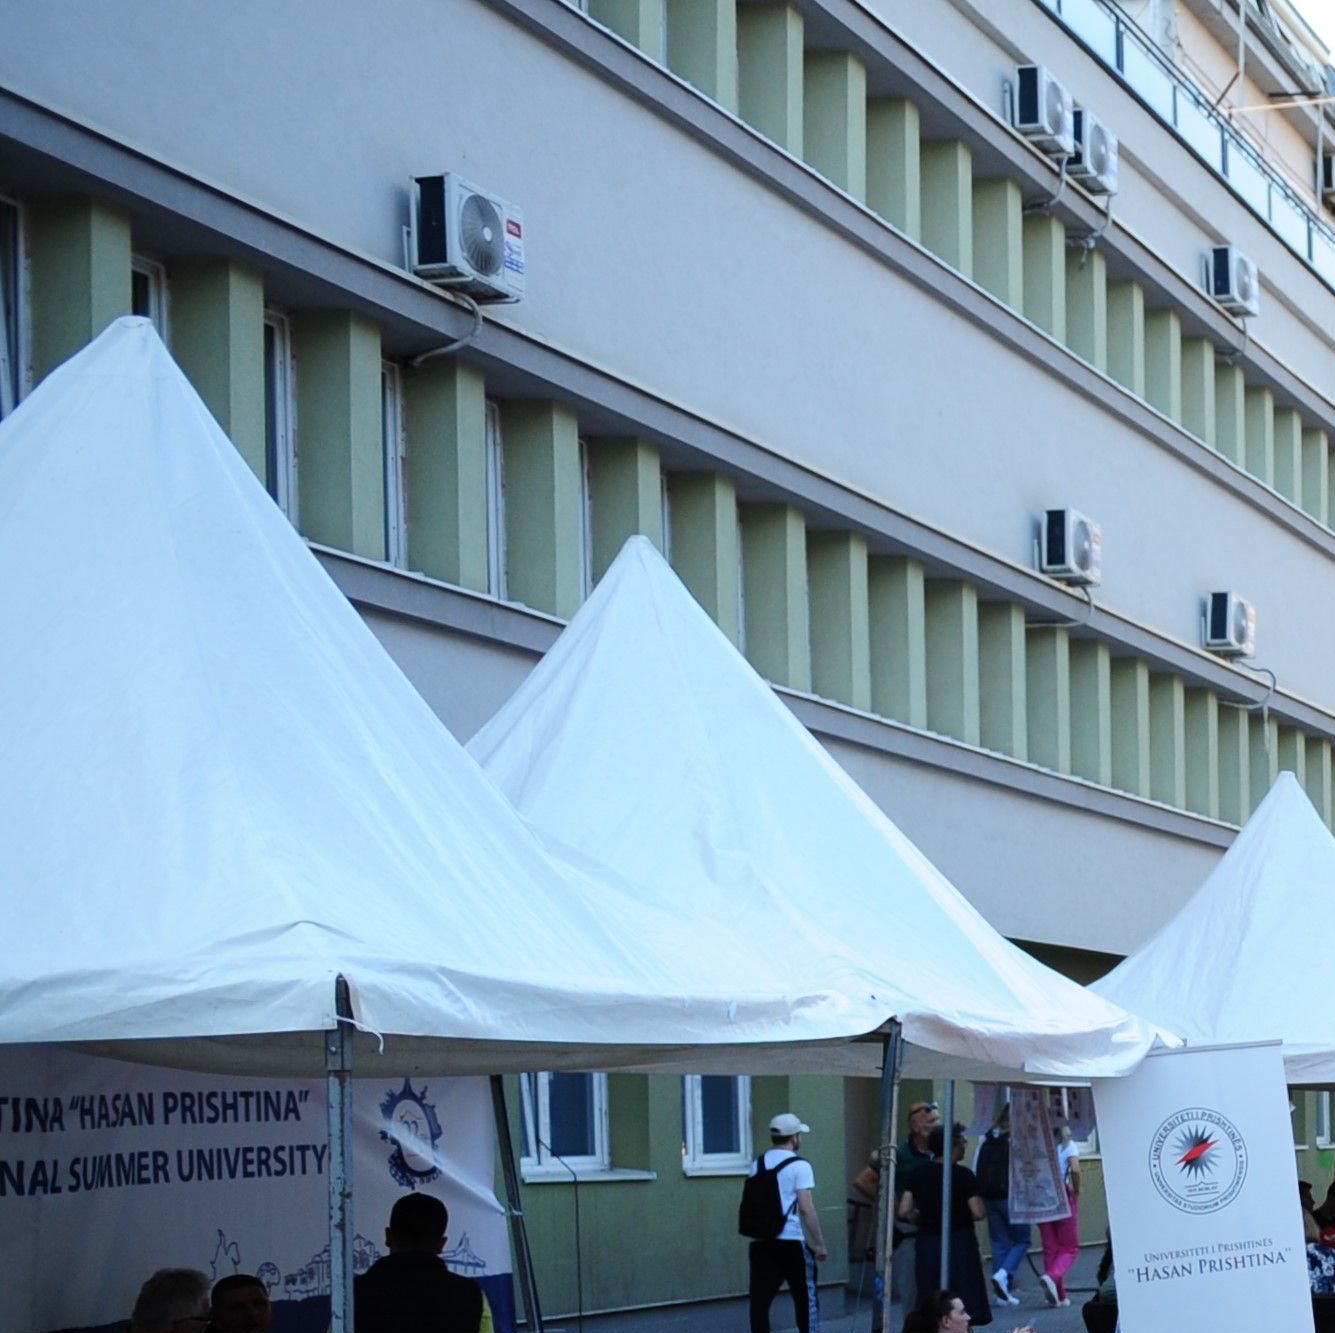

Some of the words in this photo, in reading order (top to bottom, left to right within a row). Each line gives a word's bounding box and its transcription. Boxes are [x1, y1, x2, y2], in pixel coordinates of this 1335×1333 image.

[67, 1150, 171, 1193] SUMMER
[176, 1143, 328, 1183] UNIVERSITY
[1144, 1246, 1209, 1263] UNIVERSITETI
